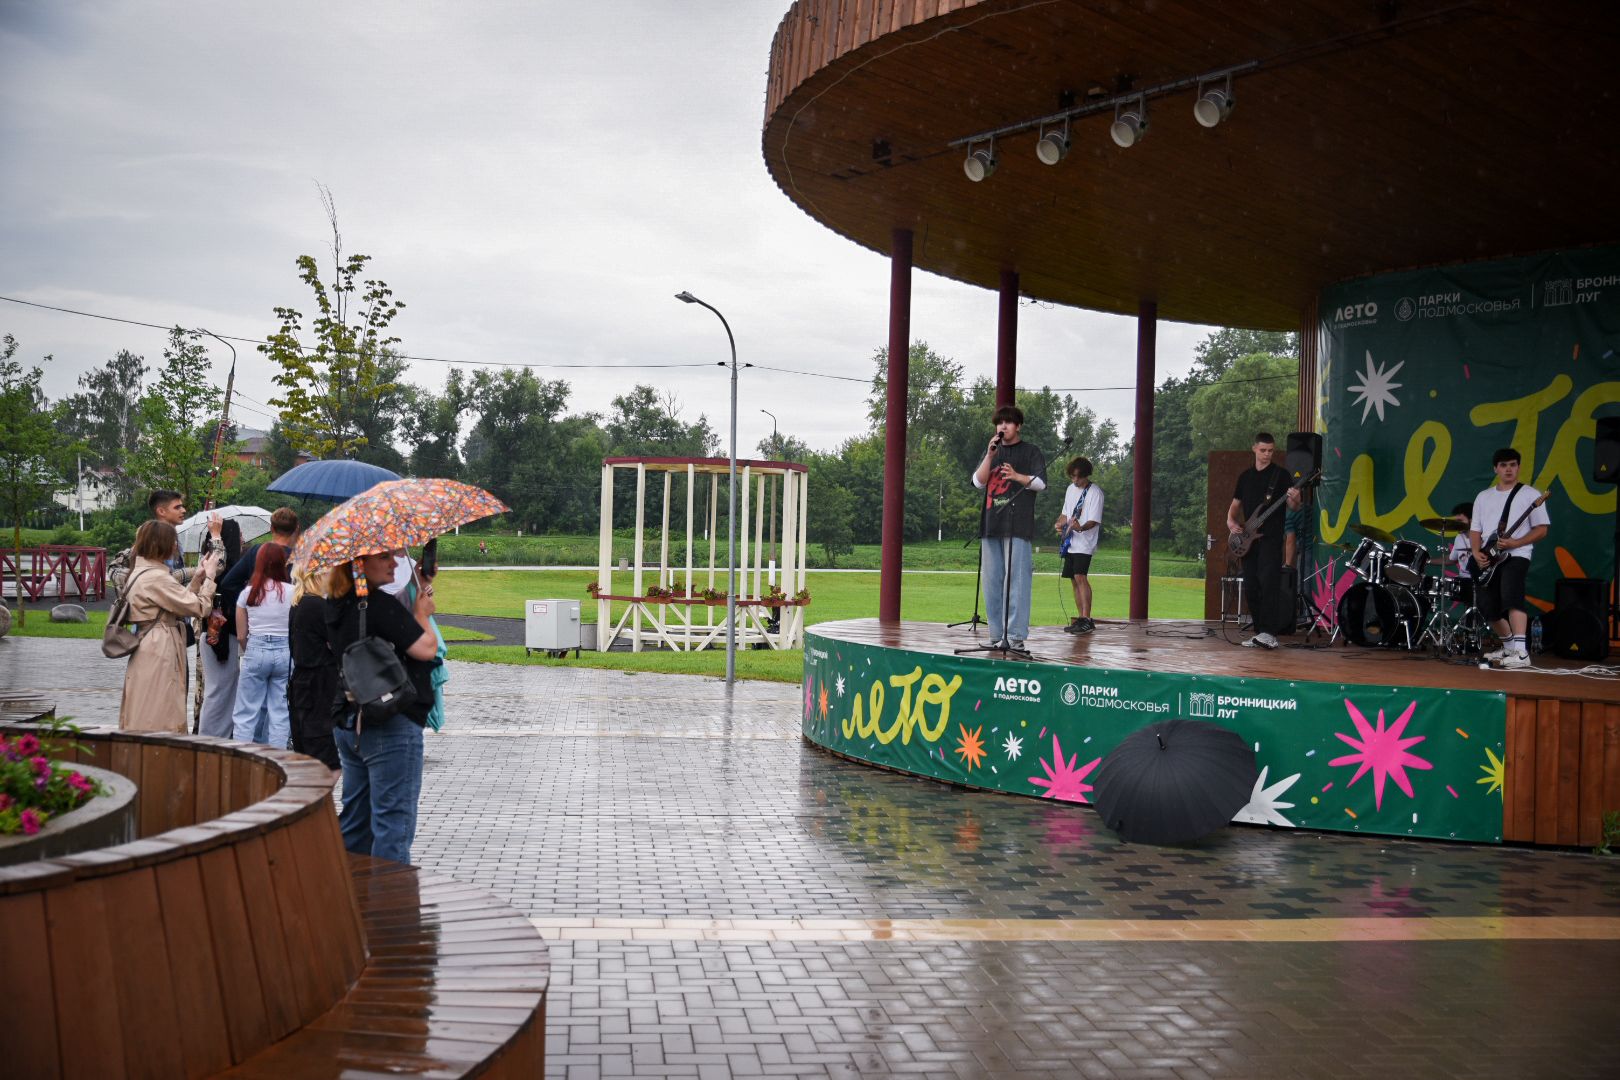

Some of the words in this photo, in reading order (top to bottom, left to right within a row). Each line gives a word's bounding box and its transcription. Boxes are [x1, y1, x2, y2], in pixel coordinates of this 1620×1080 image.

[1419, 292, 1461, 306] ПАРКИ
[1575, 291, 1601, 304] ЛУГ
[1418, 298, 1520, 319] ПОДМОСКОВЬЯ
[1081, 684, 1119, 697] ПАРКИ
[1081, 697, 1170, 713] ПОДМОСКОВЬЯ
[1217, 695, 1297, 711] БРОННИЦКИЙ
[1216, 708, 1239, 719] ЛУГ
